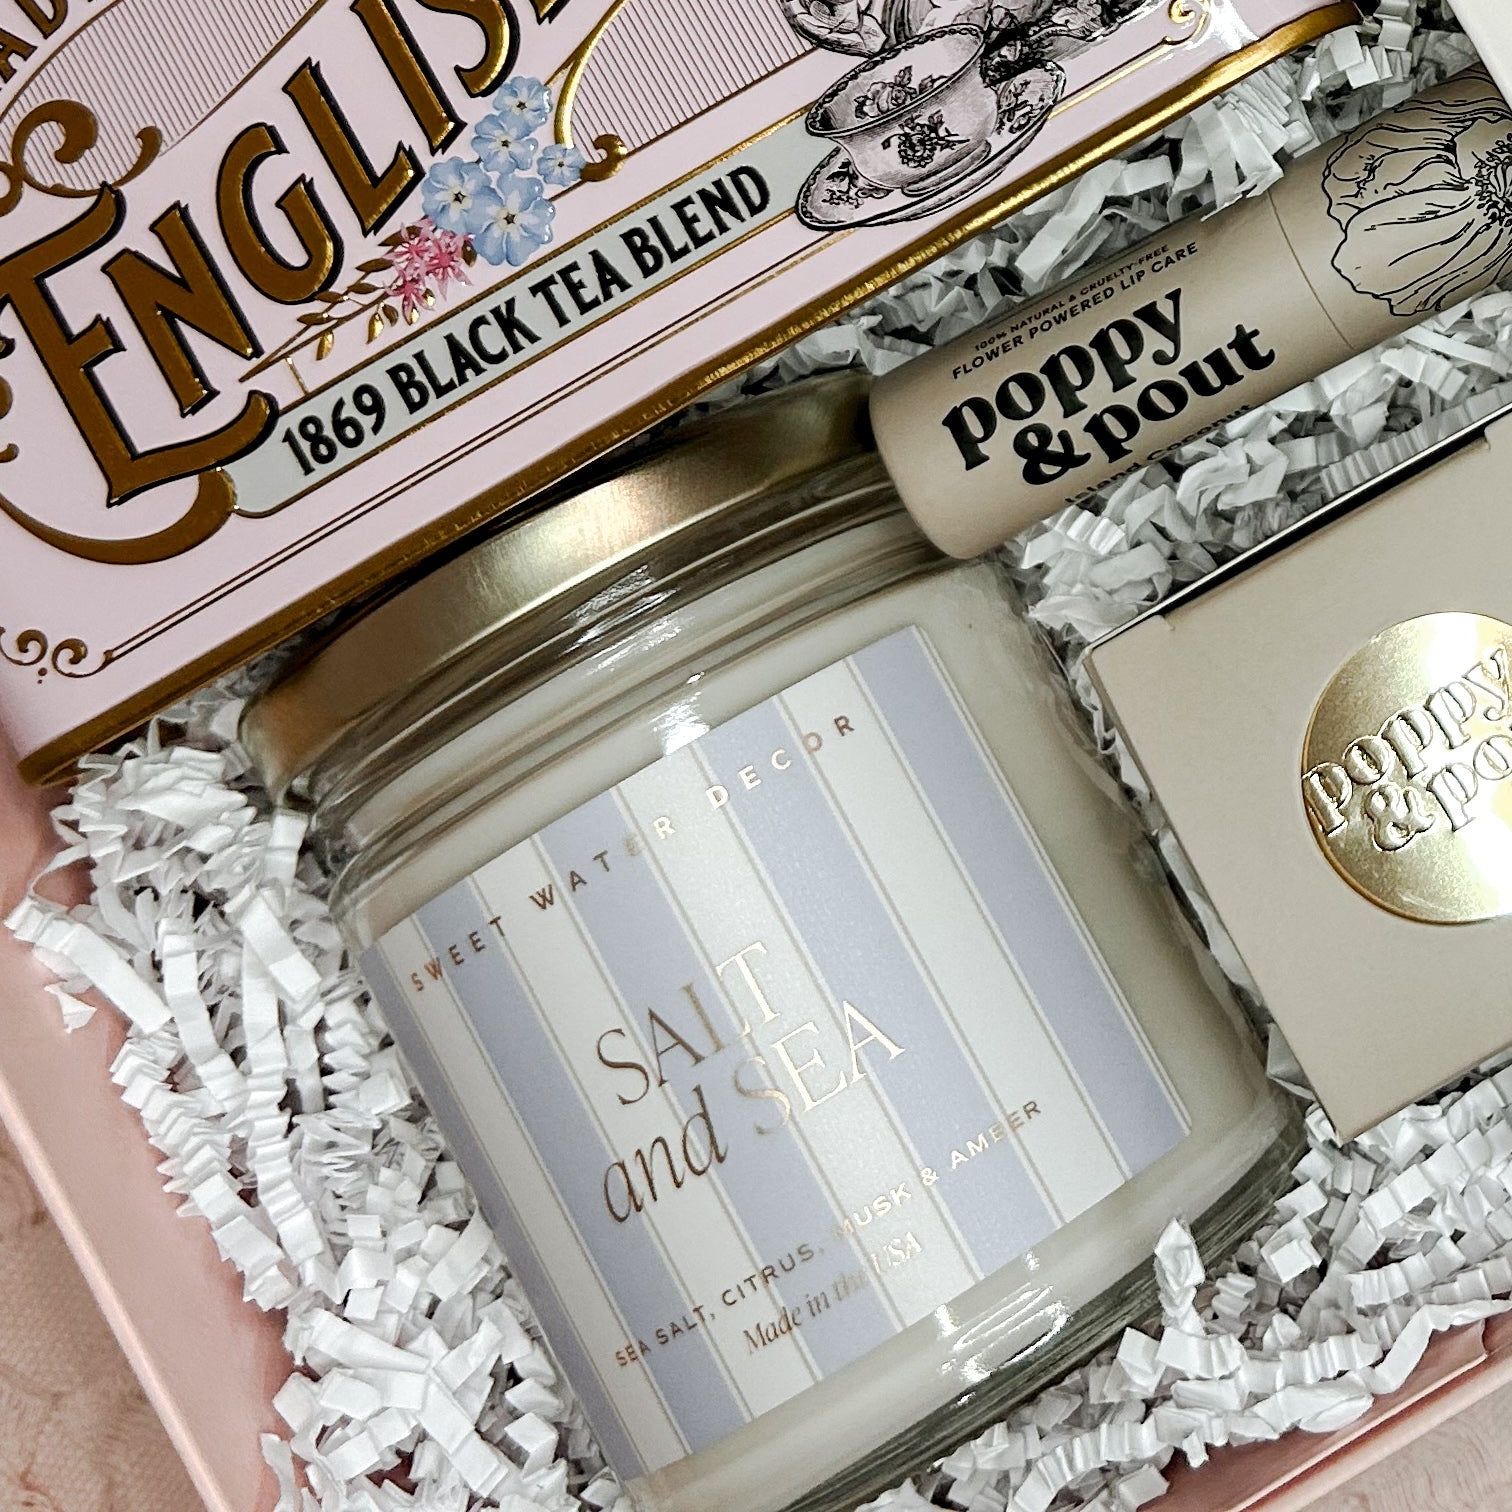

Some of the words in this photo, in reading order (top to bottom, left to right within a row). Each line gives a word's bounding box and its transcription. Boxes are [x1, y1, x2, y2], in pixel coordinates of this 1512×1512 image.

[281, 383, 387, 477] 1869
[385, 297, 542, 415] BLACK
[530, 249, 632, 329] TEA
[619, 164, 771, 280] BLEND
[941, 287, 1182, 471] poppy
[951, 335, 1025, 380] FLOWER
[1028, 289, 1115, 340] POWERED
[1118, 271, 1146, 291] LIP
[1150, 241, 1199, 274] CARE
[1009, 300, 1066, 334] NATURAL
[1080, 244, 1169, 296] CRUELTY-FREE
[1301, 643, 1511, 838] poppy
[409, 915, 507, 992] SWEET
[705, 714, 855, 810] DECOR
[596, 940, 782, 1106] SALT
[603, 1083, 729, 1223] and
[734, 999, 906, 1136] SEA
[615, 1340, 652, 1367] SEA
[919, 1166, 941, 1186] &
[949, 1099, 1042, 1170] AMBER
[742, 1305, 803, 1356] Made
[805, 1291, 831, 1318] in
[870, 1231, 923, 1276] USA
